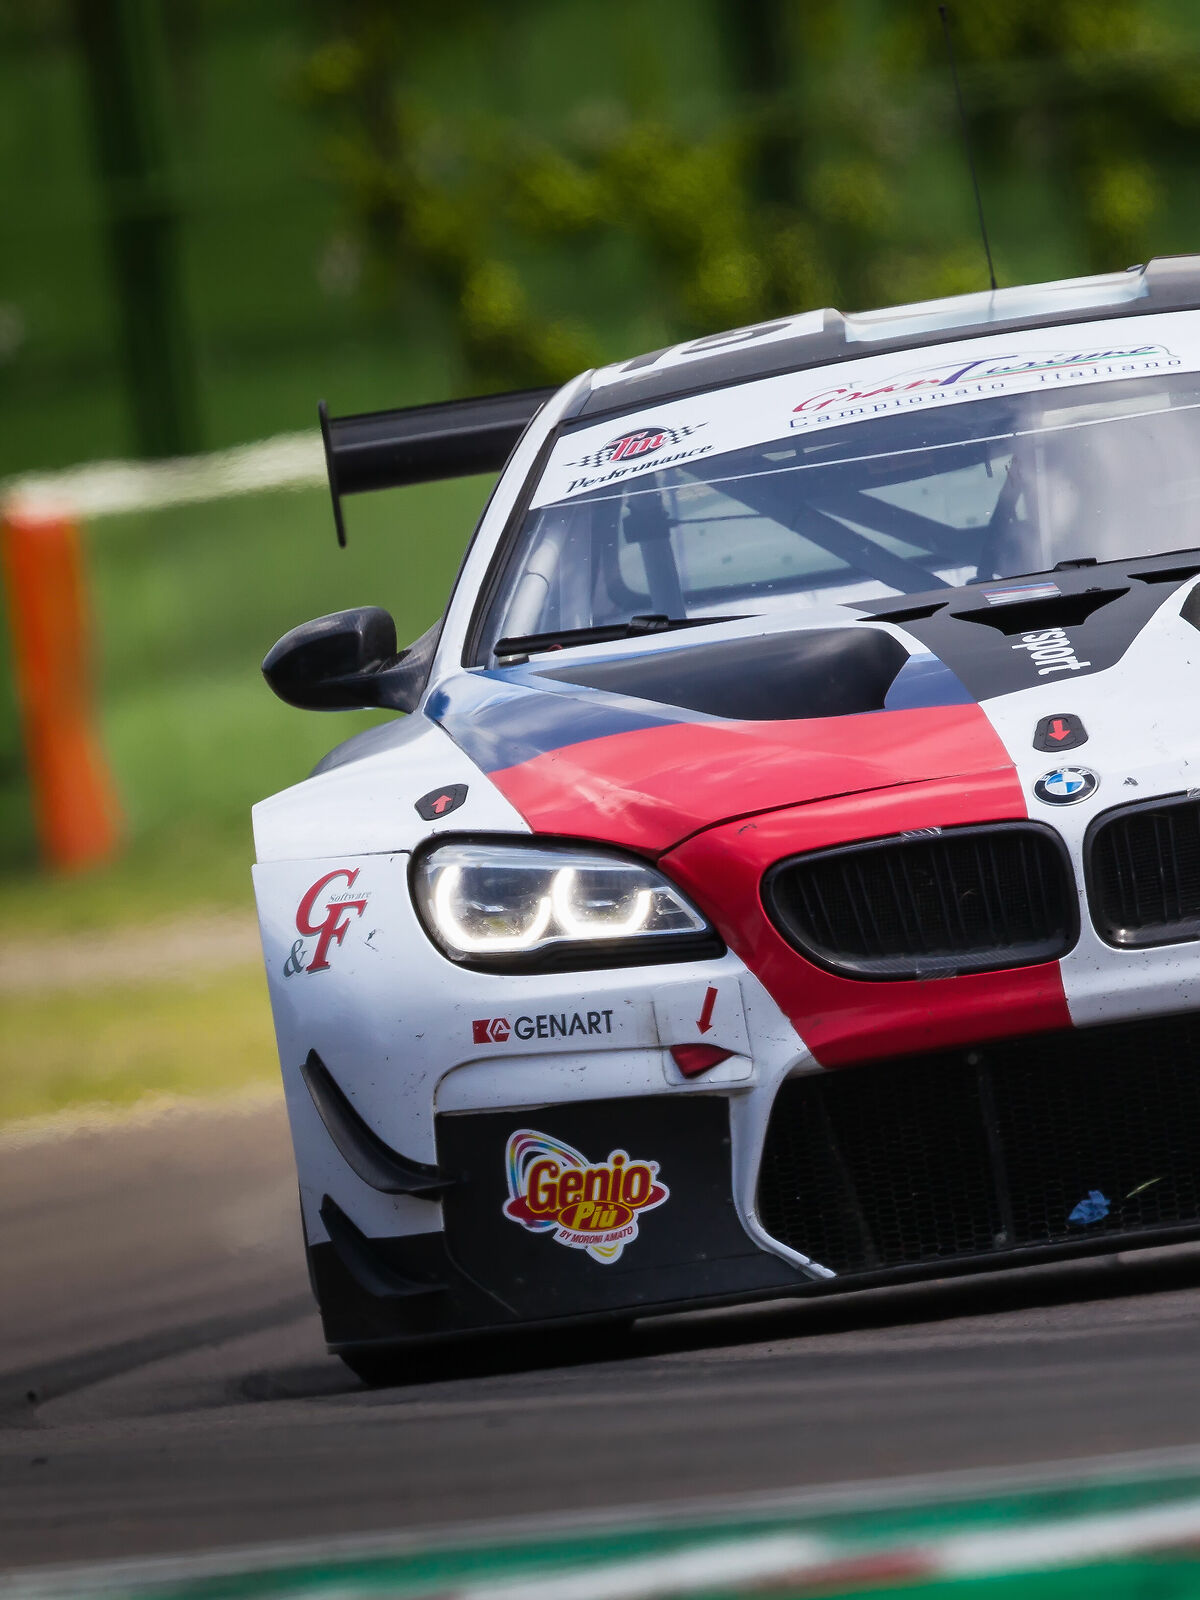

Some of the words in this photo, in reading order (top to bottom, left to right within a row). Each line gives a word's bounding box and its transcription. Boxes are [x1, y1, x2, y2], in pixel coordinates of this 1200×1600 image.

[789, 382, 1004, 428] Campionato
[1040, 359, 1181, 382] Italiano
[792, 378, 941, 412] Gran
[565, 445, 713, 493] Performance
[514, 1009, 613, 1040] GENART
[527, 1155, 652, 1214] Genio
[558, 1230, 572, 1240] BY
[603, 1225, 634, 1242] AMATO
